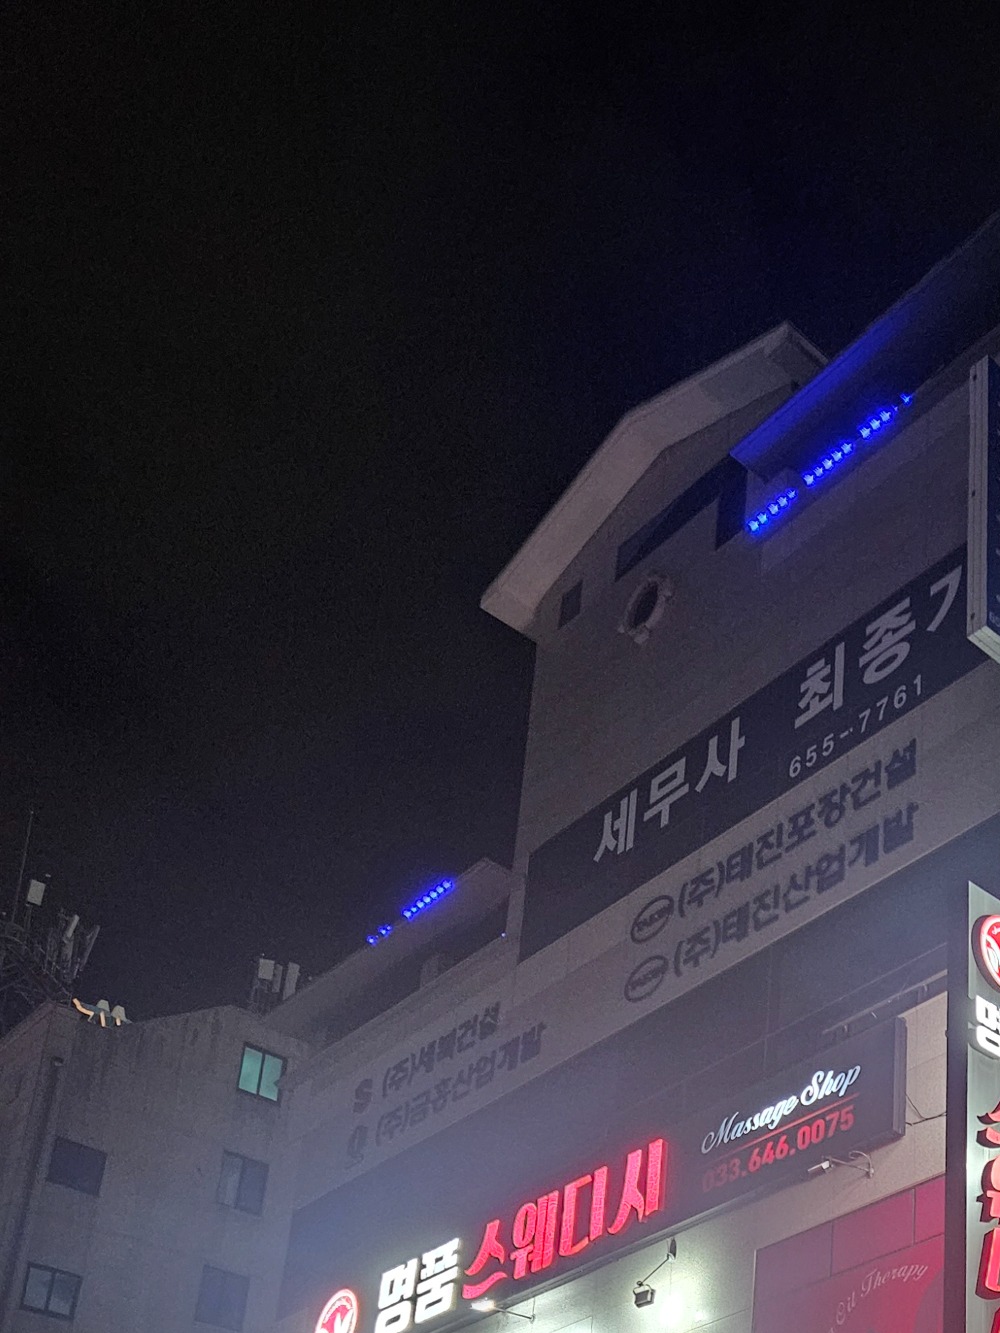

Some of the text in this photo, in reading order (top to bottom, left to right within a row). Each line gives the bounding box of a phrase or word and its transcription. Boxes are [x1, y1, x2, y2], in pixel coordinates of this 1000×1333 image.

[788, 675, 924, 778] 655-7761
[594, 717, 745, 862] 세무사
[701, 1062, 861, 1156] Massage Shop
[702, 1103, 856, 1193] 033.646.0075
[462, 1138, 667, 1300] 스웨디시
[861, 1263, 929, 1298] Therapy
